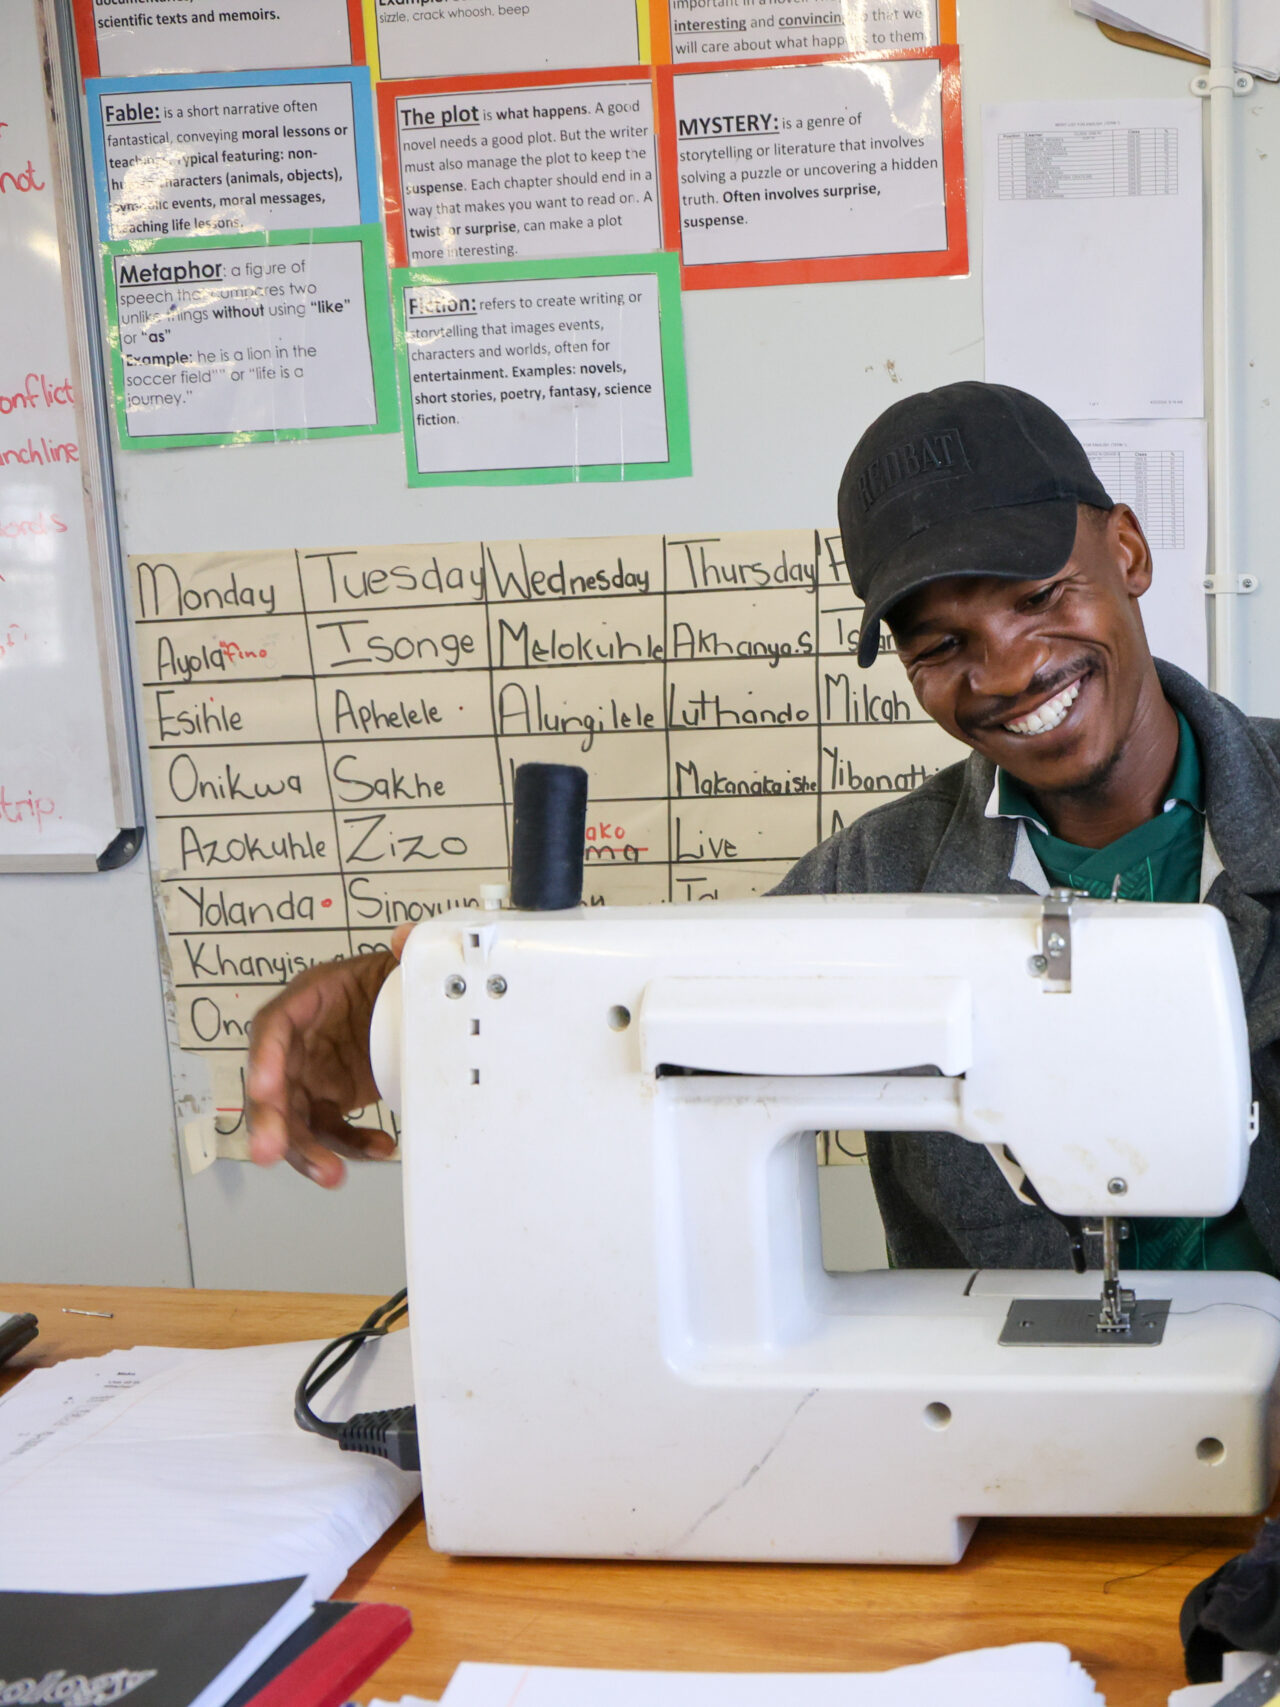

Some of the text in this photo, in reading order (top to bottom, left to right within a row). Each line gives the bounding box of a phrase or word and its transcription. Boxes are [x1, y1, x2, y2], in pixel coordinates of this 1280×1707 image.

[98, 8, 280, 28] scientific texts and memoirs.
[380, 10, 410, 23] sizzle,
[413, 7, 445, 21] crack
[498, 3, 529, 17] beep
[674, 18, 747, 34] interesting
[751, 16, 774, 29] and
[904, 9, 922, 19] we
[676, 40, 697, 54] will
[701, 40, 729, 52] care
[733, 35, 771, 50] about
[776, 35, 808, 48] what
[872, 32, 885, 43] to
[106, 100, 318, 126] Fable: is a short narrative often
[401, 100, 640, 130] The plot is what happens. A good
[679, 112, 862, 140] MYSTERY: is a genre of
[108, 126, 347, 147] fantastical, conveying moral lessons or
[222, 148, 318, 163] featuring: non-
[226, 168, 342, 185] (animals, objects),
[406, 170, 652, 196] suspense. Each chapter should end in a
[172, 197, 216, 210] events,
[220, 193, 256, 206] moral
[261, 192, 325, 207] messages,
[683, 182, 881, 206] truth. Often involves surprise,
[684, 214, 747, 229] suspense.
[120, 260, 306, 287] Metaphor: a figure of
[213, 305, 264, 319] without
[269, 303, 305, 317] using
[480, 291, 642, 310] refers to create writing or
[124, 333, 136, 344] or
[197, 349, 216, 362] he
[221, 348, 229, 361] is
[234, 351, 243, 361] a
[248, 346, 270, 360] lion
[276, 346, 288, 358] in
[293, 345, 317, 357] the
[413, 361, 626, 383] entertainment. Examples: novels,
[0, 373, 75, 415] onflict
[415, 382, 651, 404] short stories, poetry, fantasy, science
[417, 412, 459, 426] fiction.
[0, 437, 80, 466] nchline
[305, 551, 485, 603] Tuesday
[487, 544, 649, 600] Wednesday
[668, 538, 816, 594] Thursday
[137, 562, 275, 617] Monday
[498, 620, 663, 667] Melokuhle
[158, 636, 225, 681] Ayola
[156, 690, 243, 741] Esihle
[336, 688, 442, 734] Aphelele
[669, 682, 808, 729] Luthando
[169, 754, 301, 802] Onikwa
[334, 755, 446, 801] Sakhe
[0, 785, 63, 833] trip.
[181, 826, 326, 871] Azokuhle
[343, 814, 468, 863] Zizo
[676, 817, 737, 860] Live
[178, 886, 314, 927] Yolanda
[184, 939, 343, 983] Khanyis
